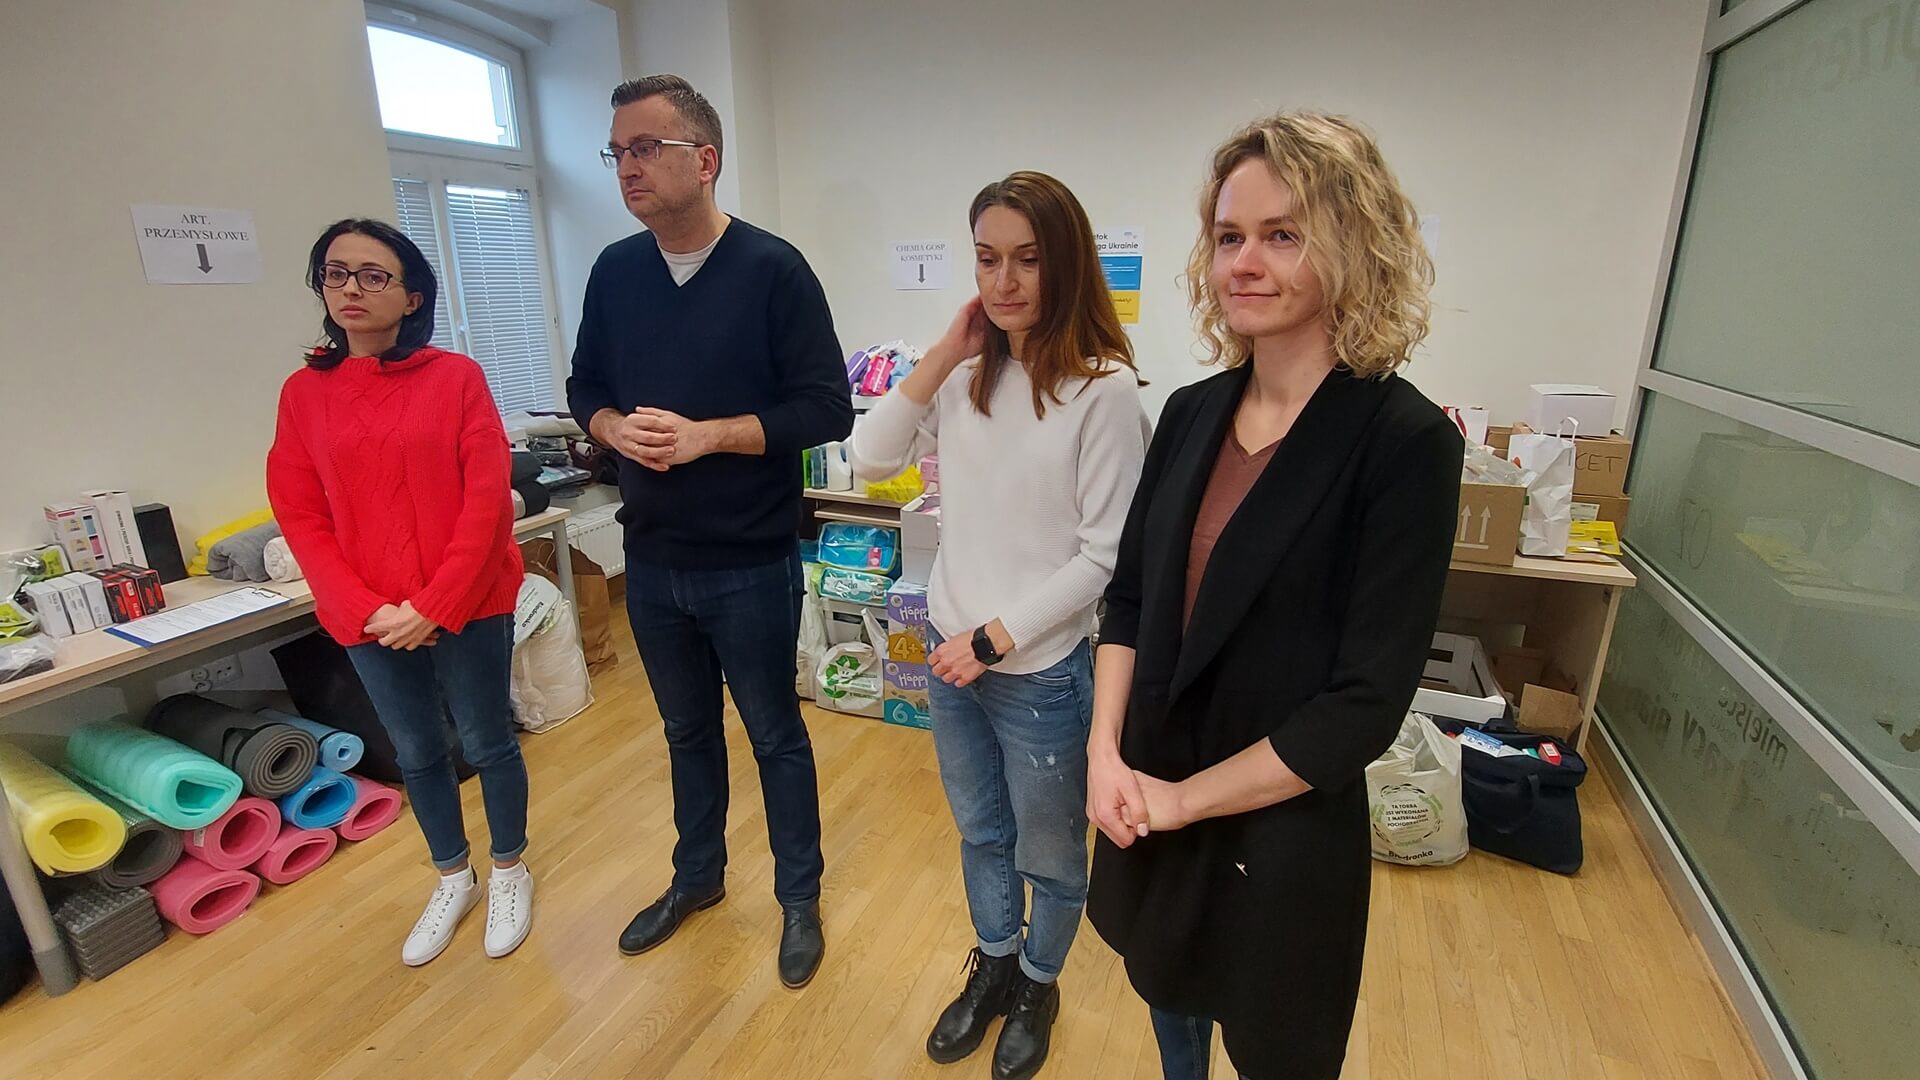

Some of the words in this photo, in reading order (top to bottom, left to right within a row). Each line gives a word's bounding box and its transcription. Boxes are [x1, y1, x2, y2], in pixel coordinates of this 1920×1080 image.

[181, 214, 211, 225] ART.
[1108, 242, 1139, 250] Ukrainie
[893, 636, 918, 659] 4+
[892, 702, 909, 723] 6
